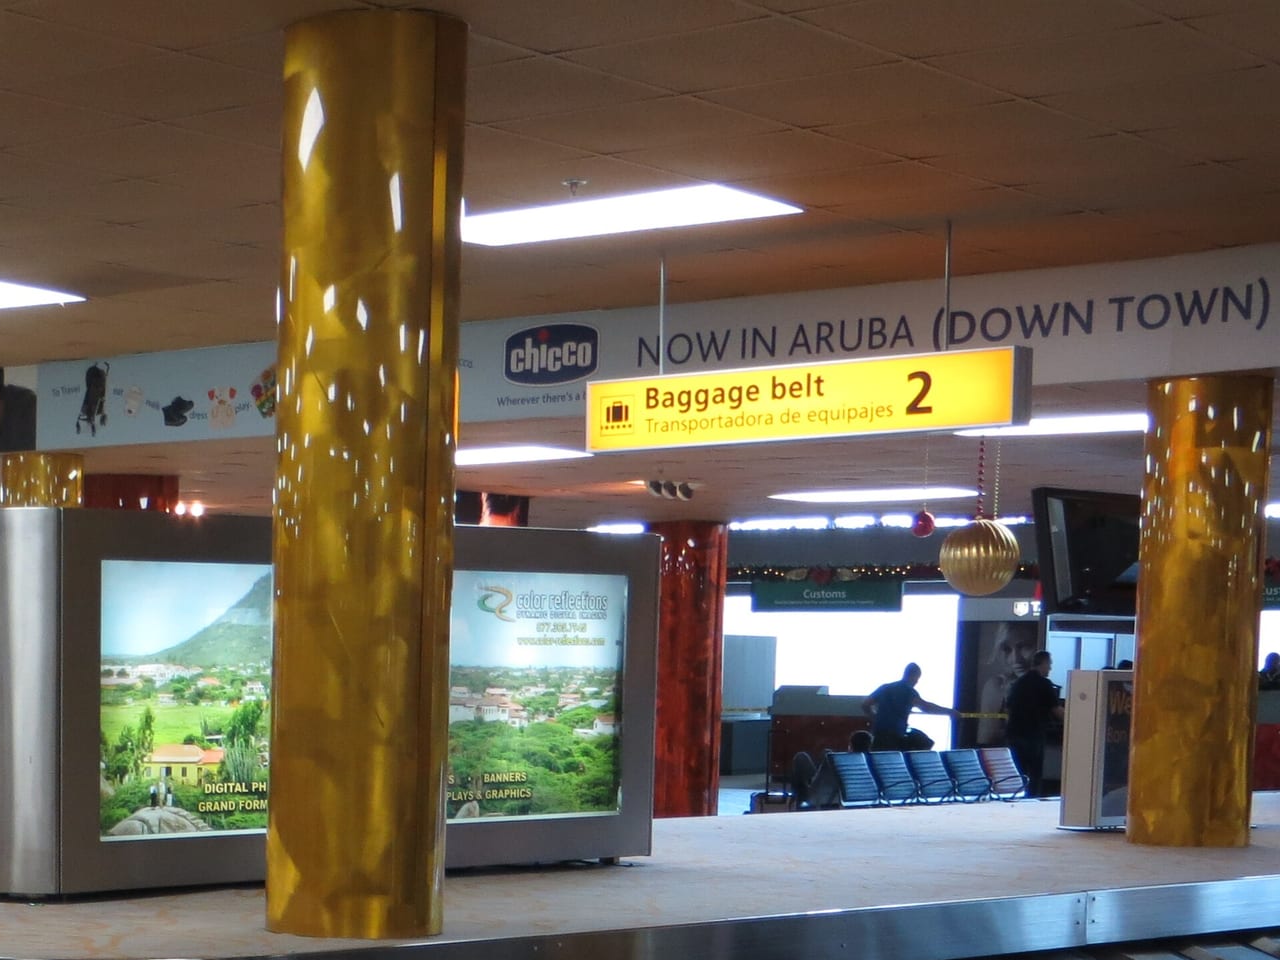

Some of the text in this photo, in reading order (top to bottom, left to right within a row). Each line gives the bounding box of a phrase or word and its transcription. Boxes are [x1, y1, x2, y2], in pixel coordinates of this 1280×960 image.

[637, 278, 1270, 367] NOW IN ARUBA (DOWN TOWN)
[510, 329, 592, 373] chicco
[645, 373, 824, 413] Baggage belt
[906, 371, 933, 415] 2
[497, 396, 540, 407] Wherever
[646, 404, 894, 434] Transportadora de equipajes
[516, 590, 608, 611] color reflections
[803, 589, 846, 599] Customs
[483, 771, 527, 783] BANNERS
[204, 782, 249, 794] DIGITAL
[485, 787, 532, 799] GRAPHICS
[198, 800, 236, 812] GRAND
